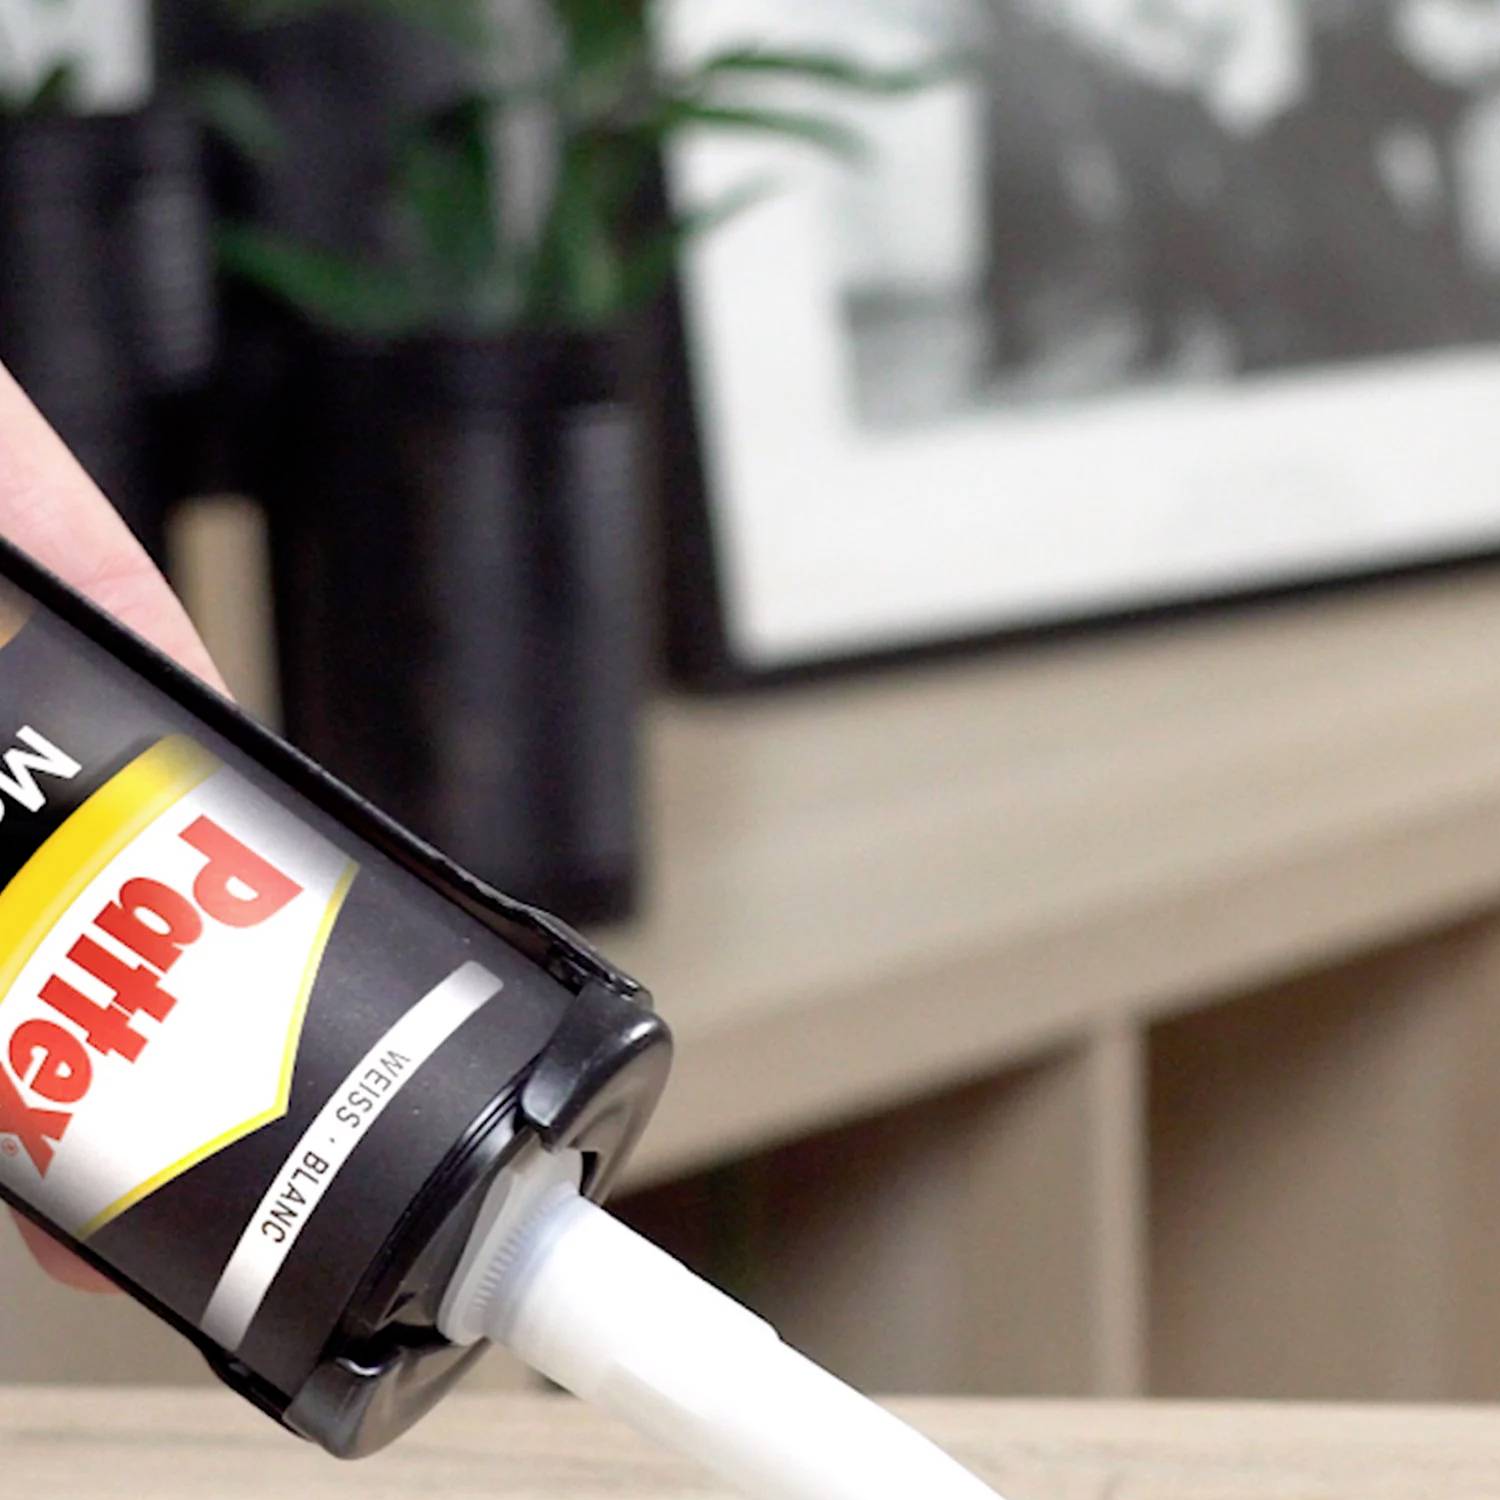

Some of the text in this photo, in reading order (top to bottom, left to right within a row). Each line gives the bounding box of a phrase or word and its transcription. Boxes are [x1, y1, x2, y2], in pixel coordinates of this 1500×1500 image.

[0, 724, 82, 823] M
[0, 814, 304, 1180] Pattex
[261, 1050, 411, 1243] WEISS BLANC
